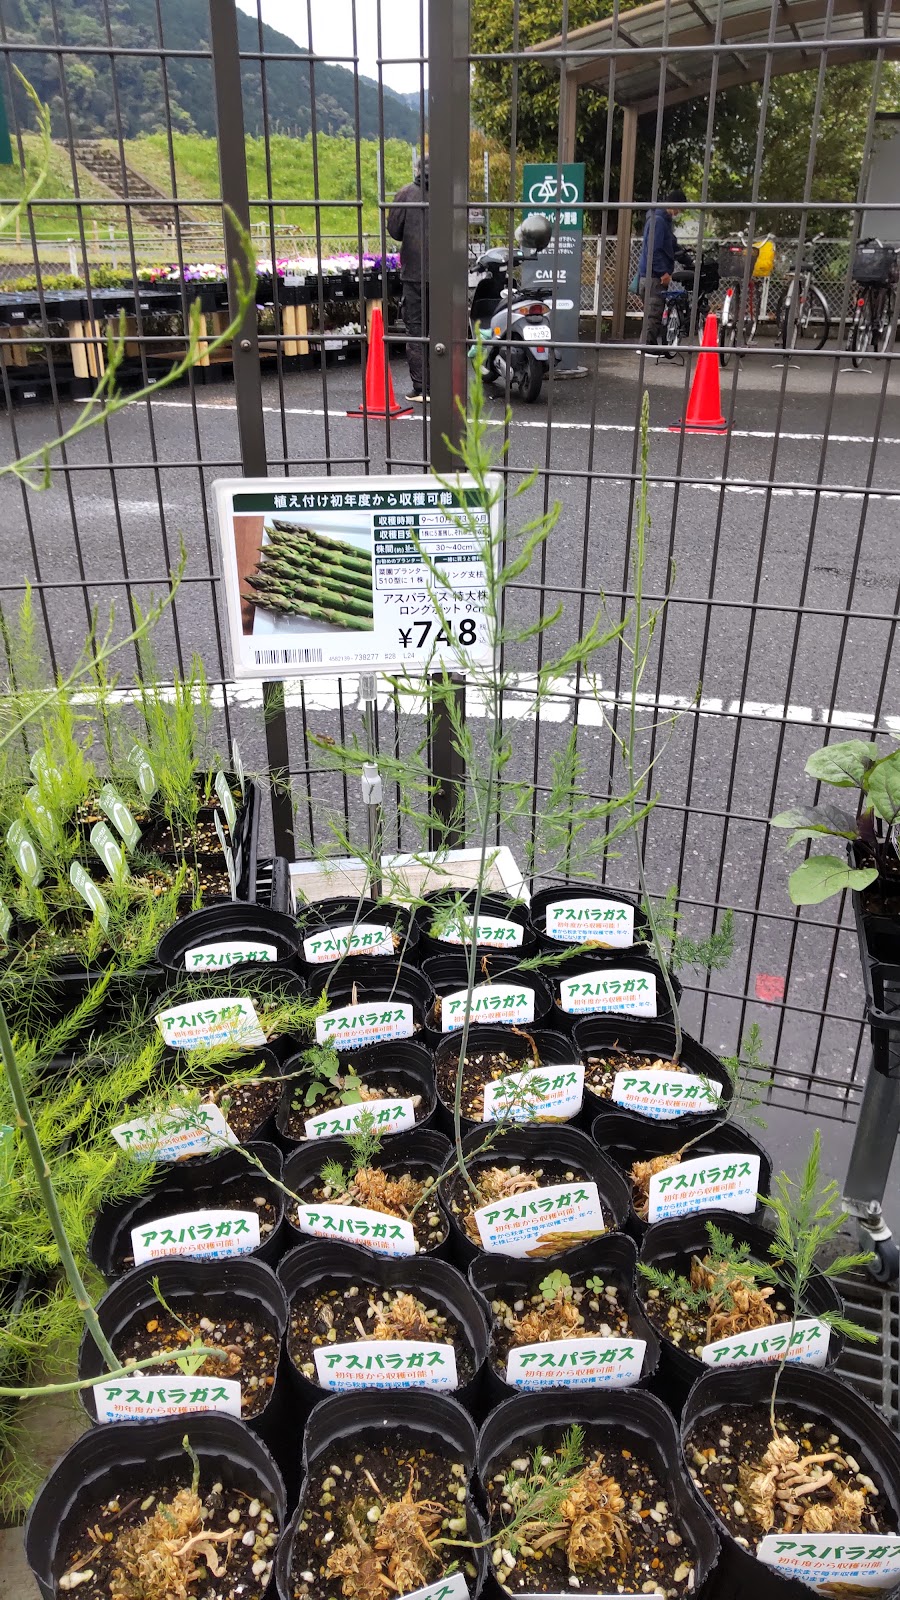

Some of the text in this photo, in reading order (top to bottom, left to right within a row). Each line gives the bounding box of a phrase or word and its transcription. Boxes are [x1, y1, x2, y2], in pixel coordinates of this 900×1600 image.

[274, 491, 452, 508] 植え付け初年度から収穫可能
[379, 515, 414, 526] 収穫時期
[379, 567, 429, 576] 菜園プランター
[398, 618, 477, 648] ¥748
[552, 908, 627, 921] アスパラガス
[310, 931, 385, 954] アスパラガス
[192, 951, 270, 966] アスパラガス
[567, 978, 649, 997] アスパラガス
[448, 993, 528, 1014] アスパラガス
[574, 994, 641, 1006] 初年度から収穫可能！
[323, 1009, 406, 1031] アスパラガス
[622, 1077, 714, 1099] アスパラガス
[313, 1105, 407, 1136] アスパガス
[658, 1161, 752, 1193] アスパラガス
[664, 1181, 742, 1202] 初年度から収穫可能！
[484, 1189, 590, 1225] アスパラガス
[305, 1212, 405, 1240] アスパラガス
[495, 1205, 582, 1233] 初年度から収穫可能！
[141, 1218, 250, 1247] アスパラガス
[150, 1238, 241, 1257] 初年度から収穫可能！
[712, 1326, 822, 1362] アスパラガス
[324, 1351, 445, 1369] アスパラガス
[519, 1346, 635, 1367] アスパラガス
[335, 1369, 435, 1380] 初年度から収穫可能！
[525, 1364, 622, 1378] 初年度から収穫可能！
[104, 1386, 230, 1404] アスパラガス
[774, 1541, 900, 1560] アスパラガス
[778, 1556, 890, 1569] 初年度から収穫可能！
